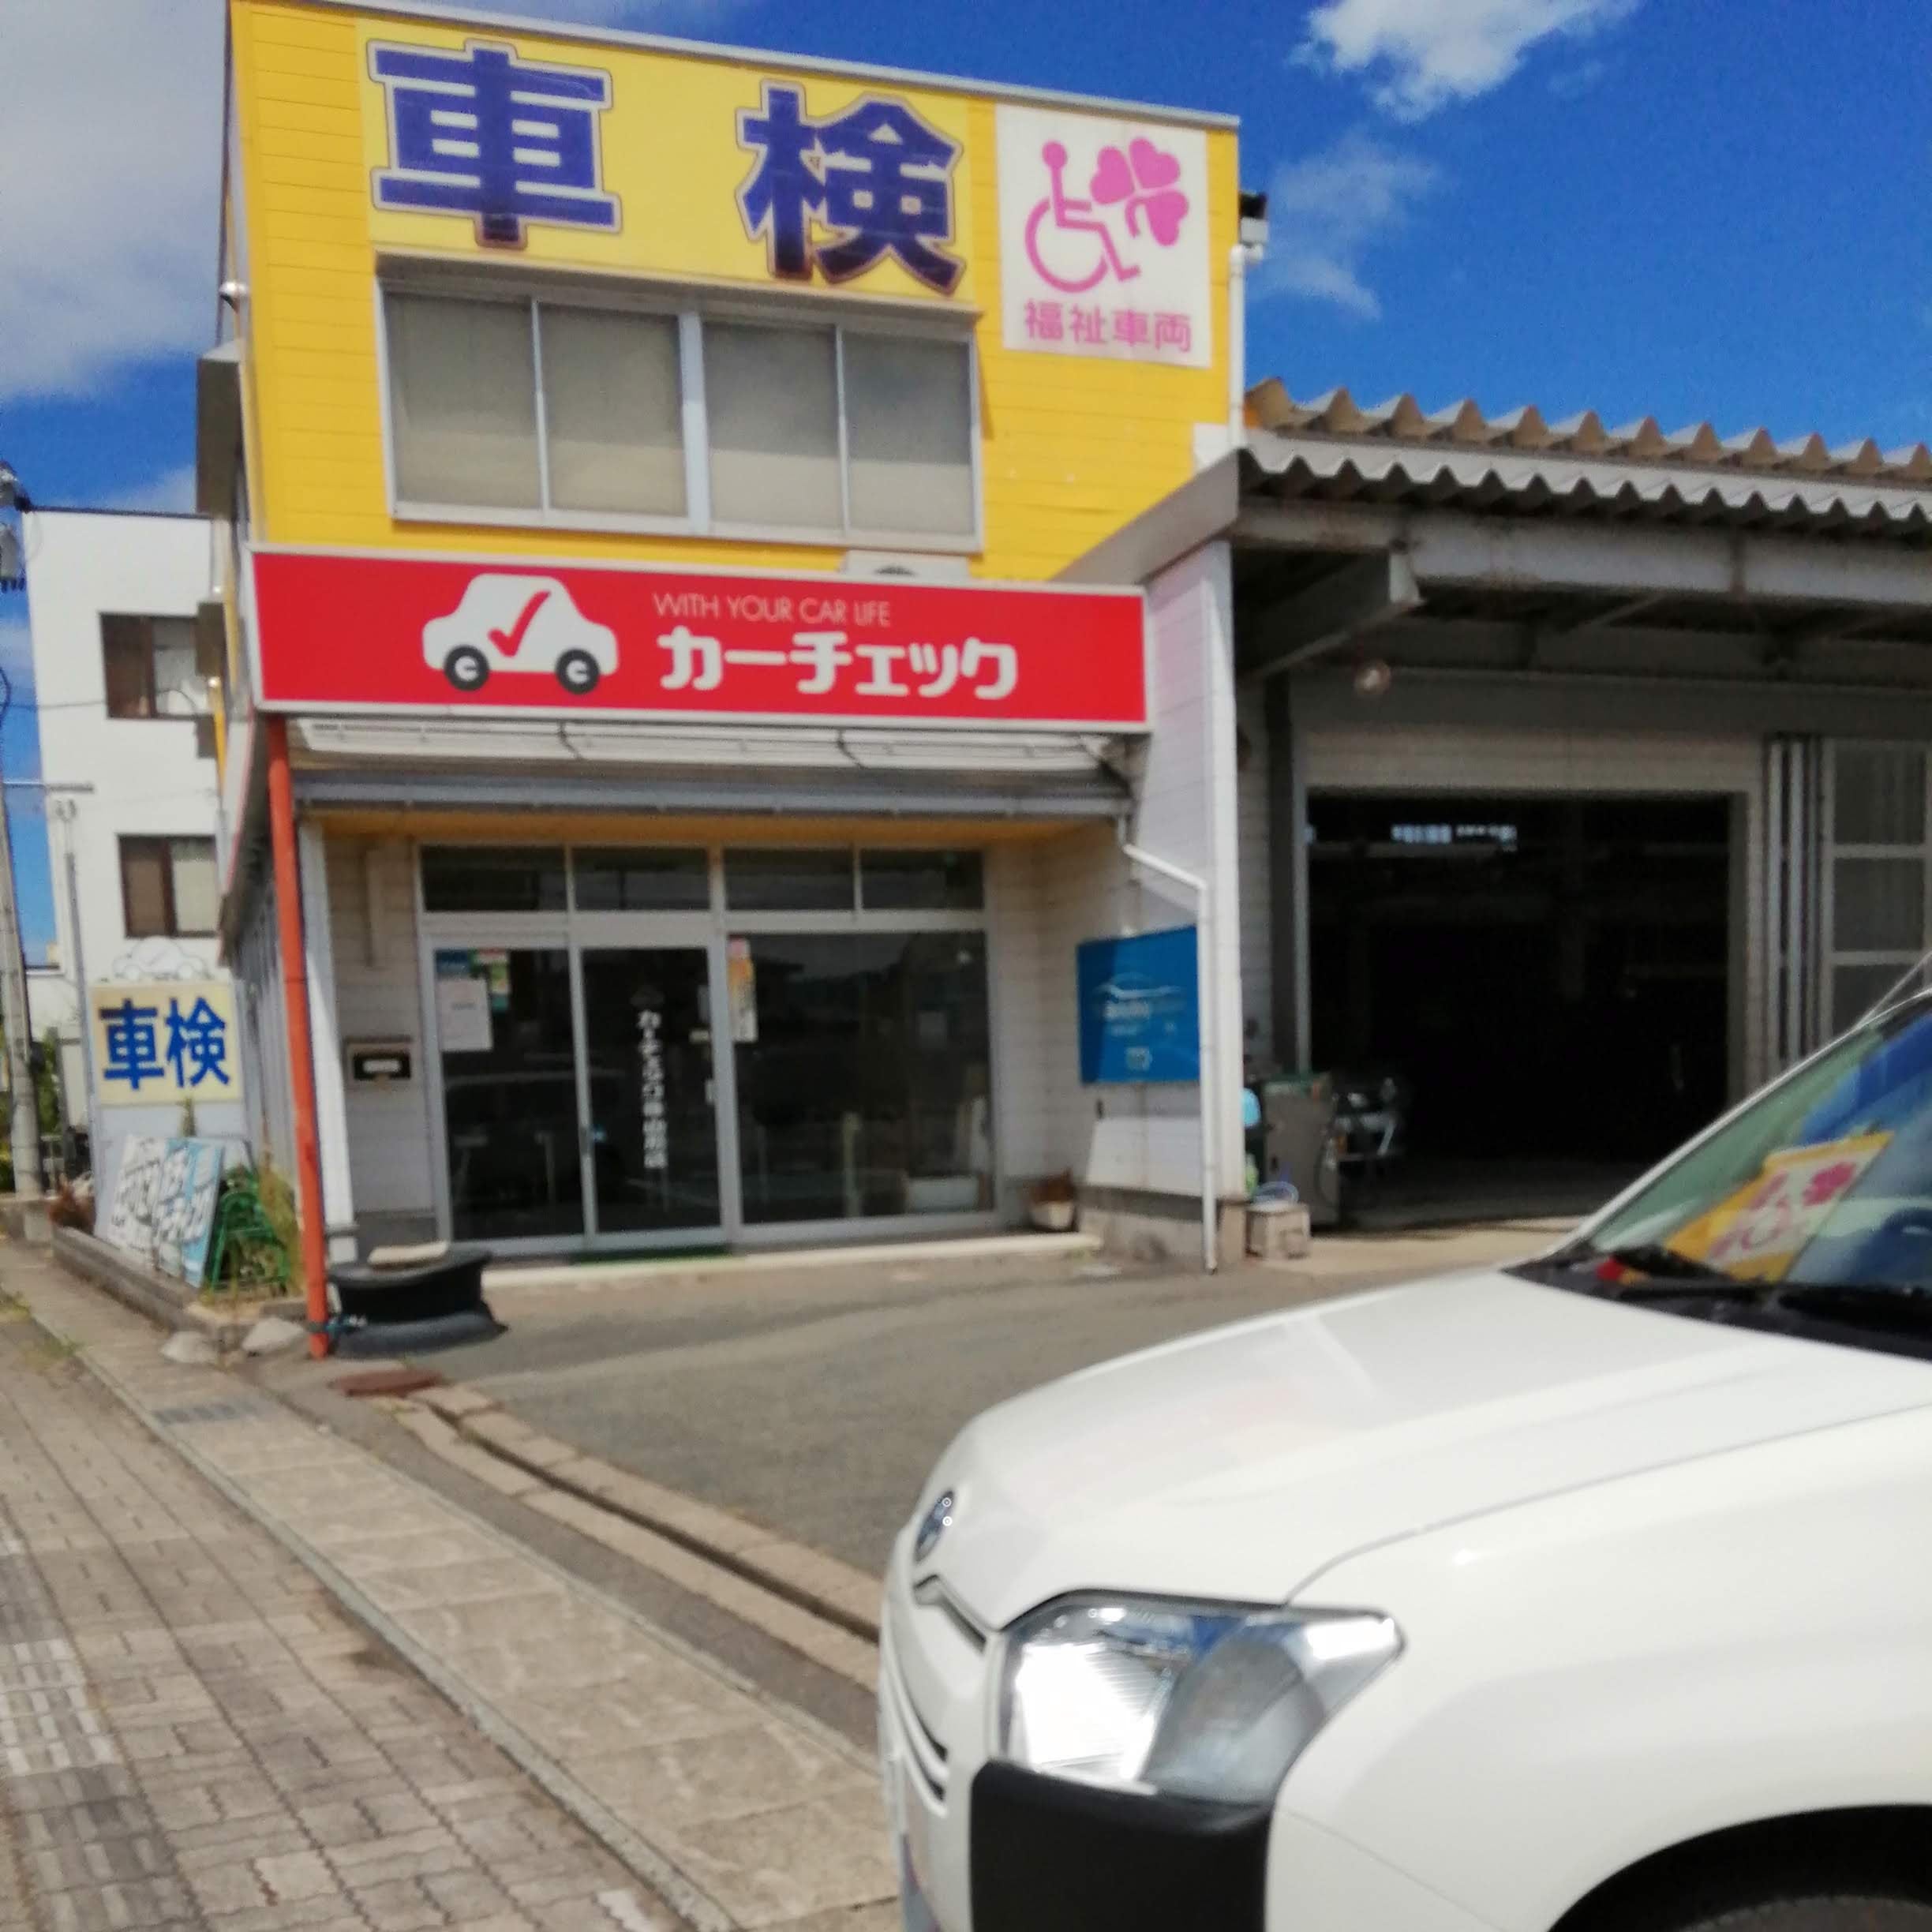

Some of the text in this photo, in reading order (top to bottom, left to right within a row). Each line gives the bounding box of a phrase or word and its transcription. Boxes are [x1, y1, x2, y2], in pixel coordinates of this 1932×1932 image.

[368, 39, 964, 295] 車検
[1024, 298, 1193, 353] 福祉車両
[653, 592, 891, 627] WITH YOUR CAR LIFE
[657, 624, 1018, 699] カーチェック
[99, 997, 230, 1091] 車検
